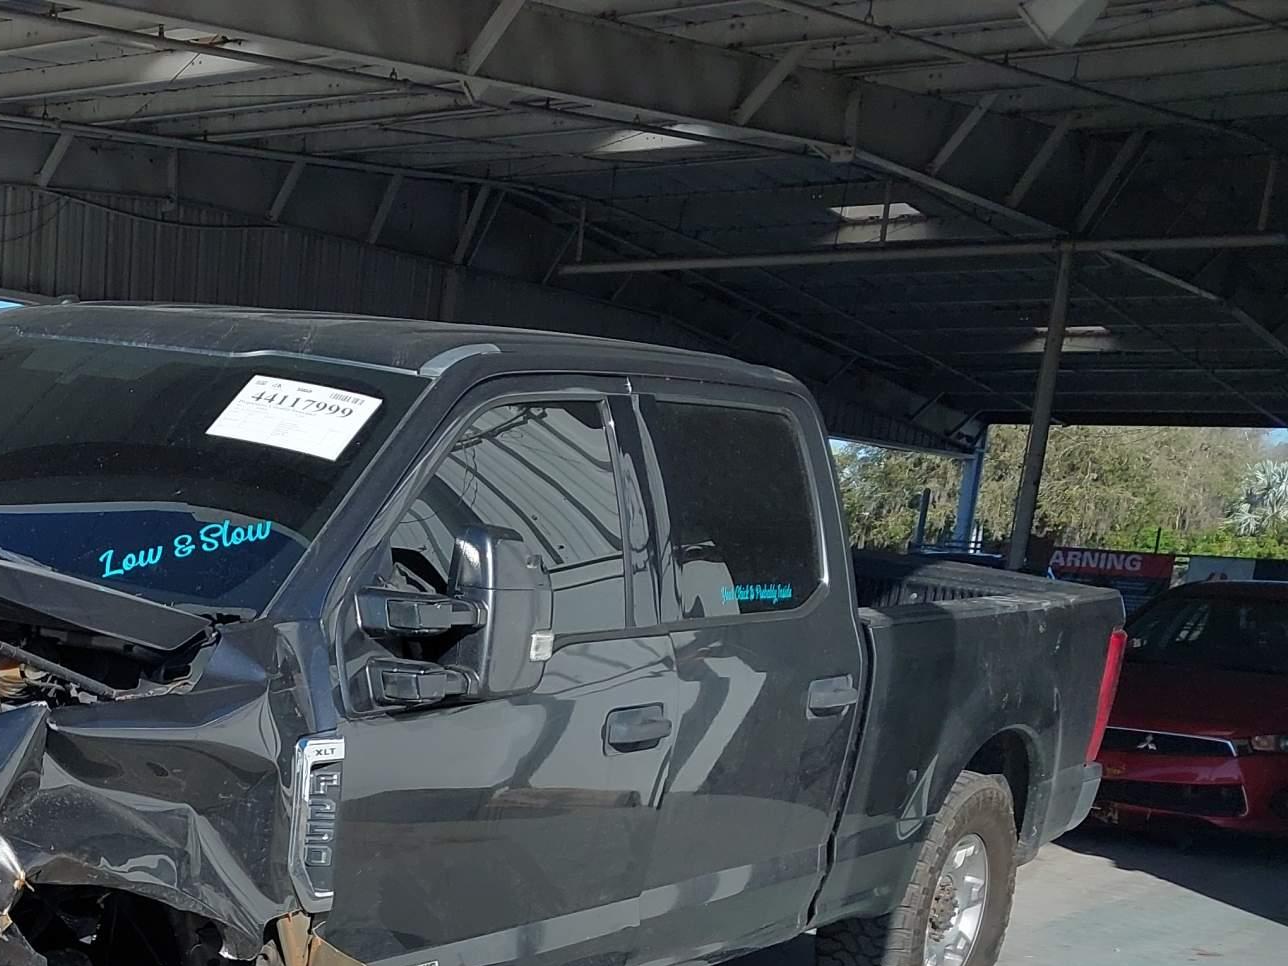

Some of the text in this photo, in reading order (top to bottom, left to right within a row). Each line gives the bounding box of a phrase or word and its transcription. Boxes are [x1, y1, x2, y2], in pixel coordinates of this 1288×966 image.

[251, 390, 354, 418] 44117999
[98, 519, 272, 579] Low & Slow
[1049, 550, 1144, 571] ARNING
[314, 747, 337, 756] XLT
